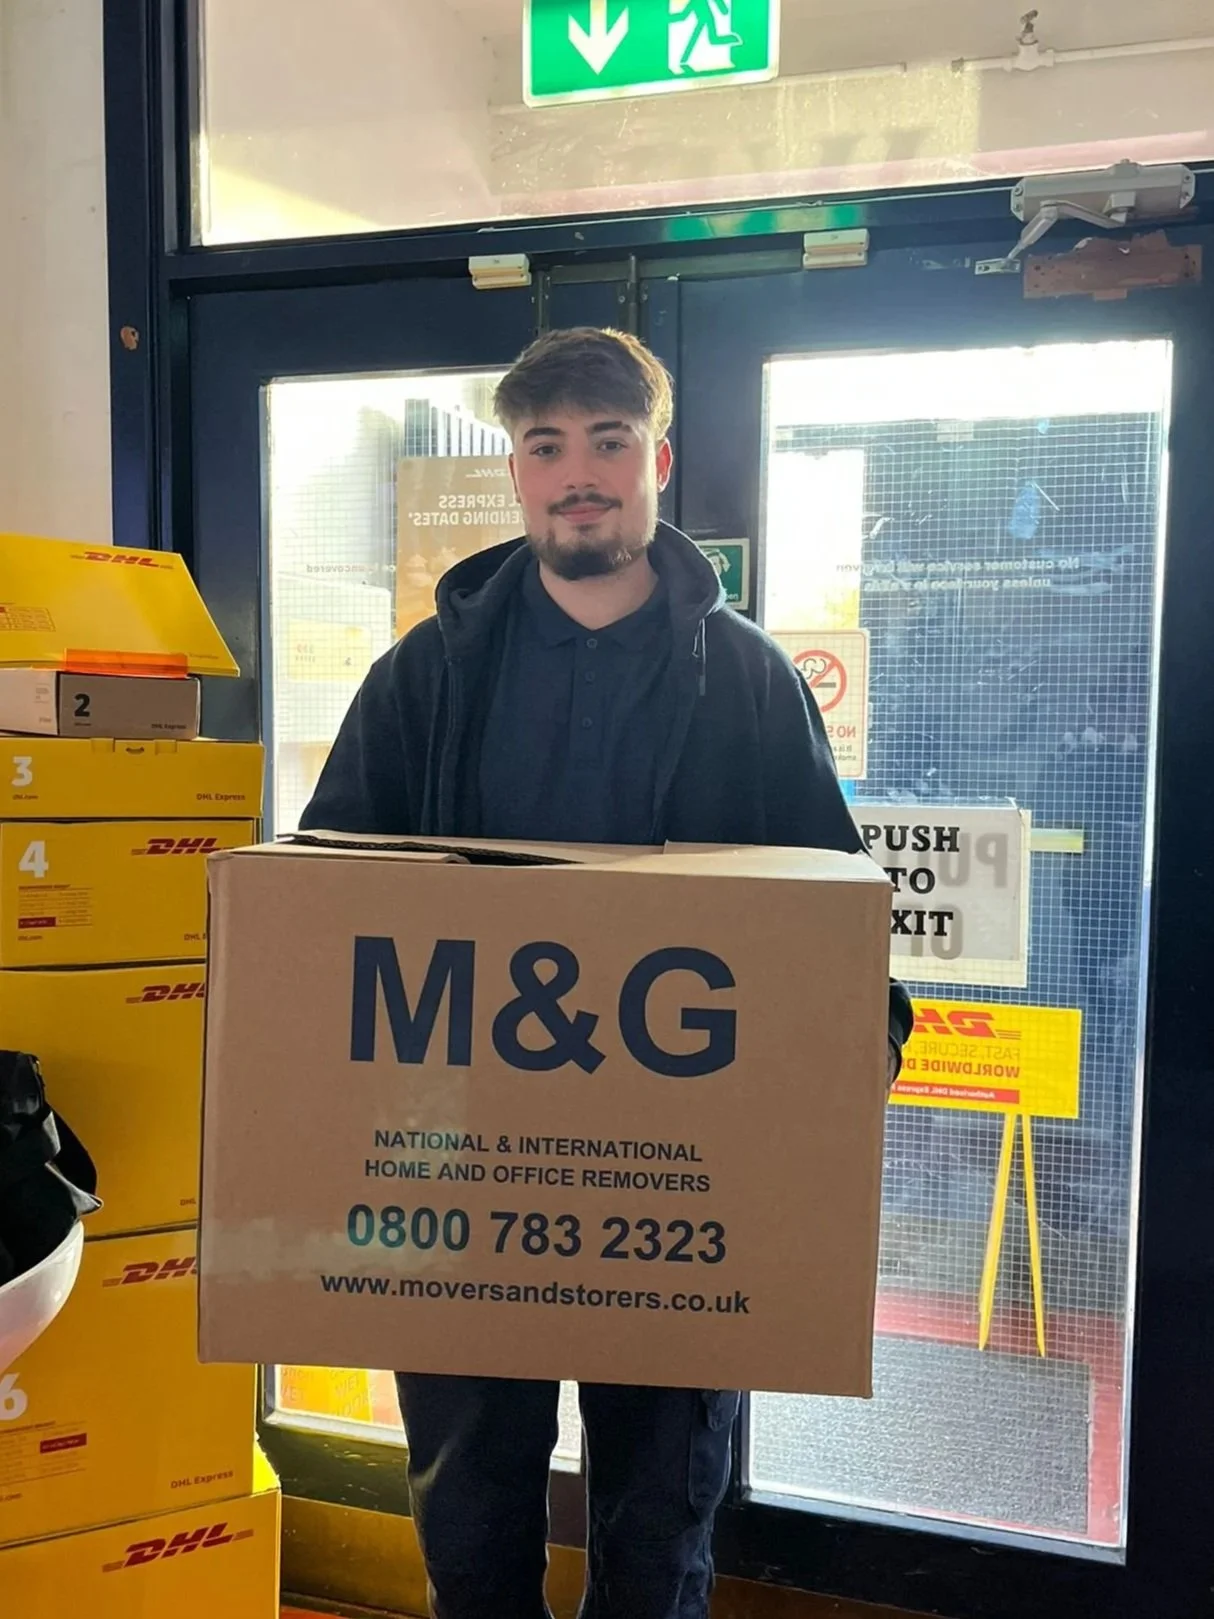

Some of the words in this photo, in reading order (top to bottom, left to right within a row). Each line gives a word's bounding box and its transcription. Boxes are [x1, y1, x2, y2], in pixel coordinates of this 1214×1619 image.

[84, 551, 159, 568] DHL
[74, 693, 91, 717] 2
[11, 756, 33, 786] 3
[196, 793, 214, 801] DHL
[215, 793, 246, 803] Express
[147, 837, 218, 855] DHL
[860, 824, 960, 853] PUSH
[18, 840, 49, 878] 4
[885, 866, 936, 894] TO
[891, 909, 954, 936] XIT
[350, 935, 738, 1078] M&G
[374, 1129, 490, 1153] NATIONAL
[496, 1134, 512, 1154] &
[518, 1136, 703, 1162] INTERNATIONAL
[364, 1159, 431, 1180] HOME
[437, 1162, 486, 1182] AND
[493, 1164, 575, 1187] OFFICE
[581, 1169, 711, 1193] REMOVERS
[347, 1203, 471, 1252] 0800
[489, 1210, 582, 1258] 783
[600, 1216, 727, 1264] 2323
[320, 1273, 751, 1314] www.moversandstorers.co.uk
[0, 1372, 29, 1421] 6
[170, 1477, 193, 1490] DHL
[194, 1469, 234, 1488] Express
[124, 1522, 235, 1568] DHL
